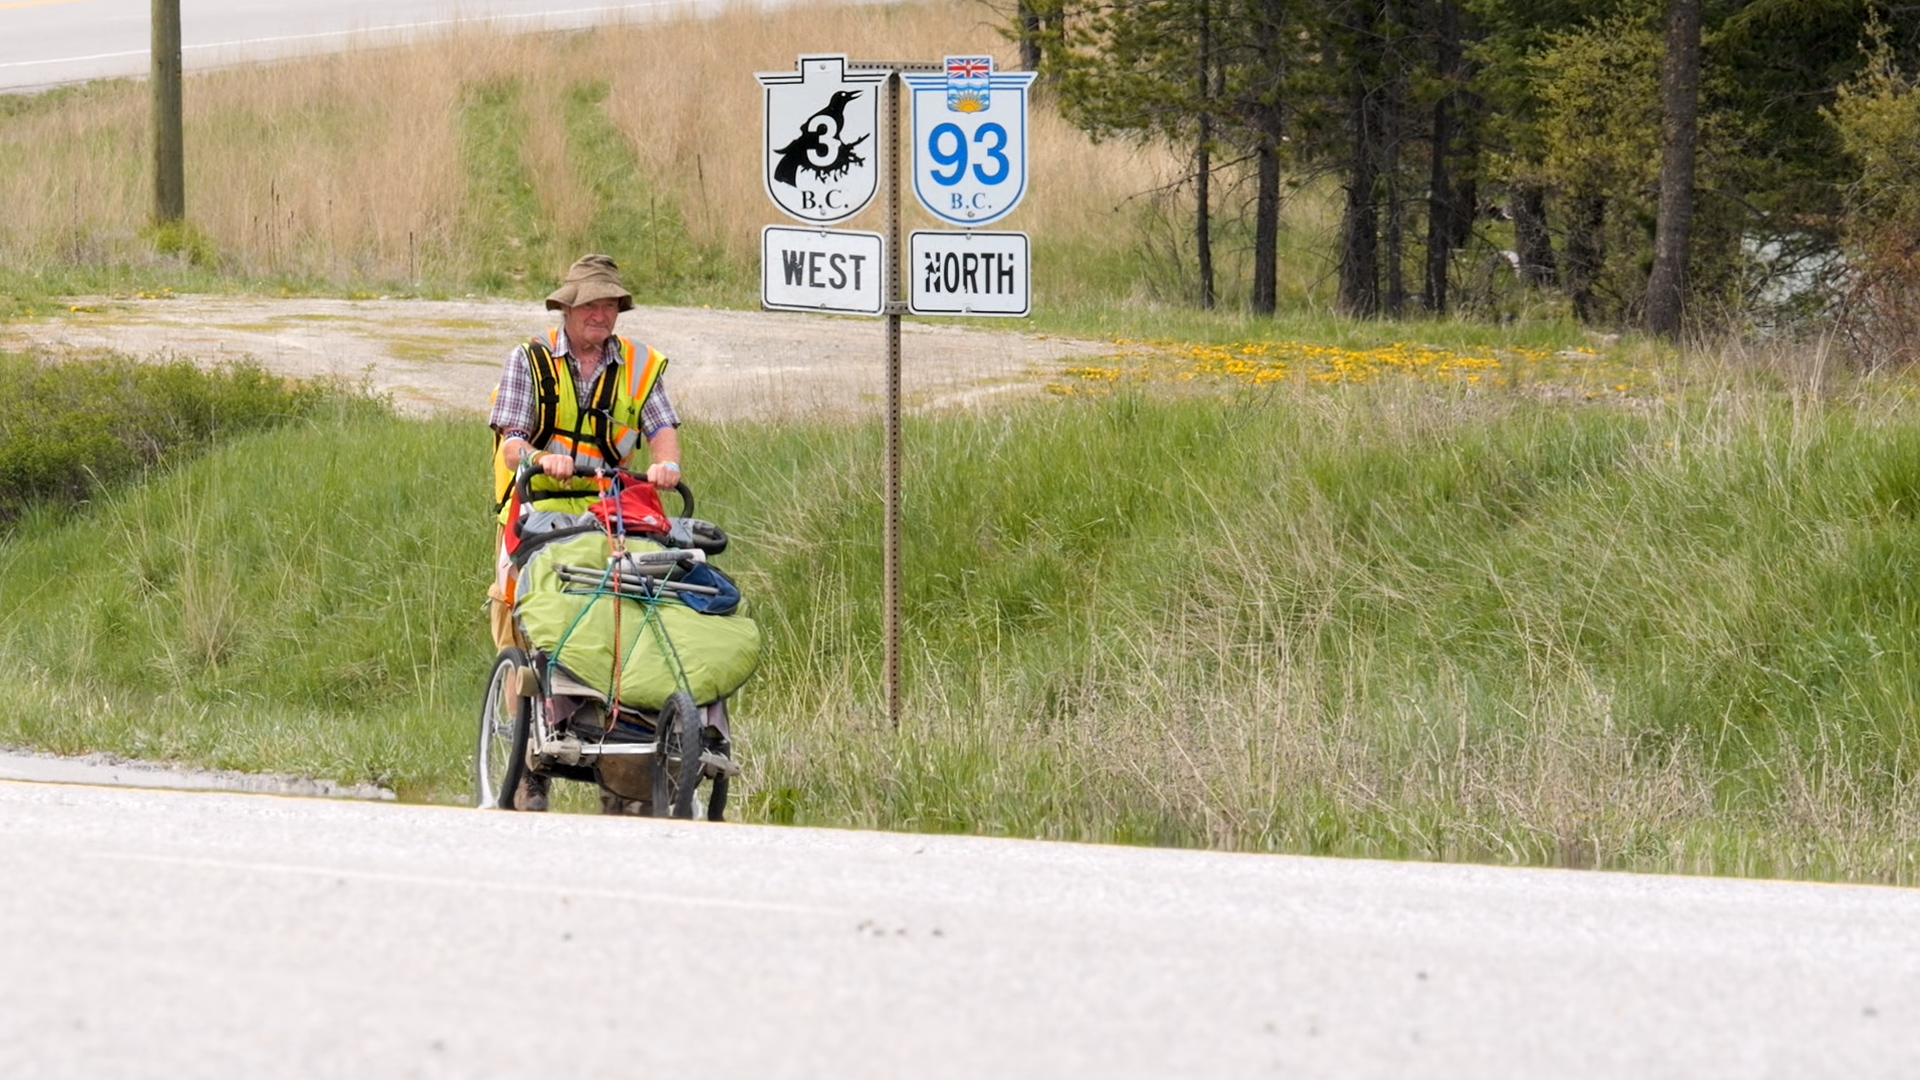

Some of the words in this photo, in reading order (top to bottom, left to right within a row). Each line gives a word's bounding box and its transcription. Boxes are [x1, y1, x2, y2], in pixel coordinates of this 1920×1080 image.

[806, 114, 840, 167] 3
[928, 122, 1010, 186] 93
[801, 189, 848, 209] B.C.
[951, 192, 992, 209] B.C.
[782, 249, 866, 291] WEST
[924, 252, 1014, 294] NORTH
